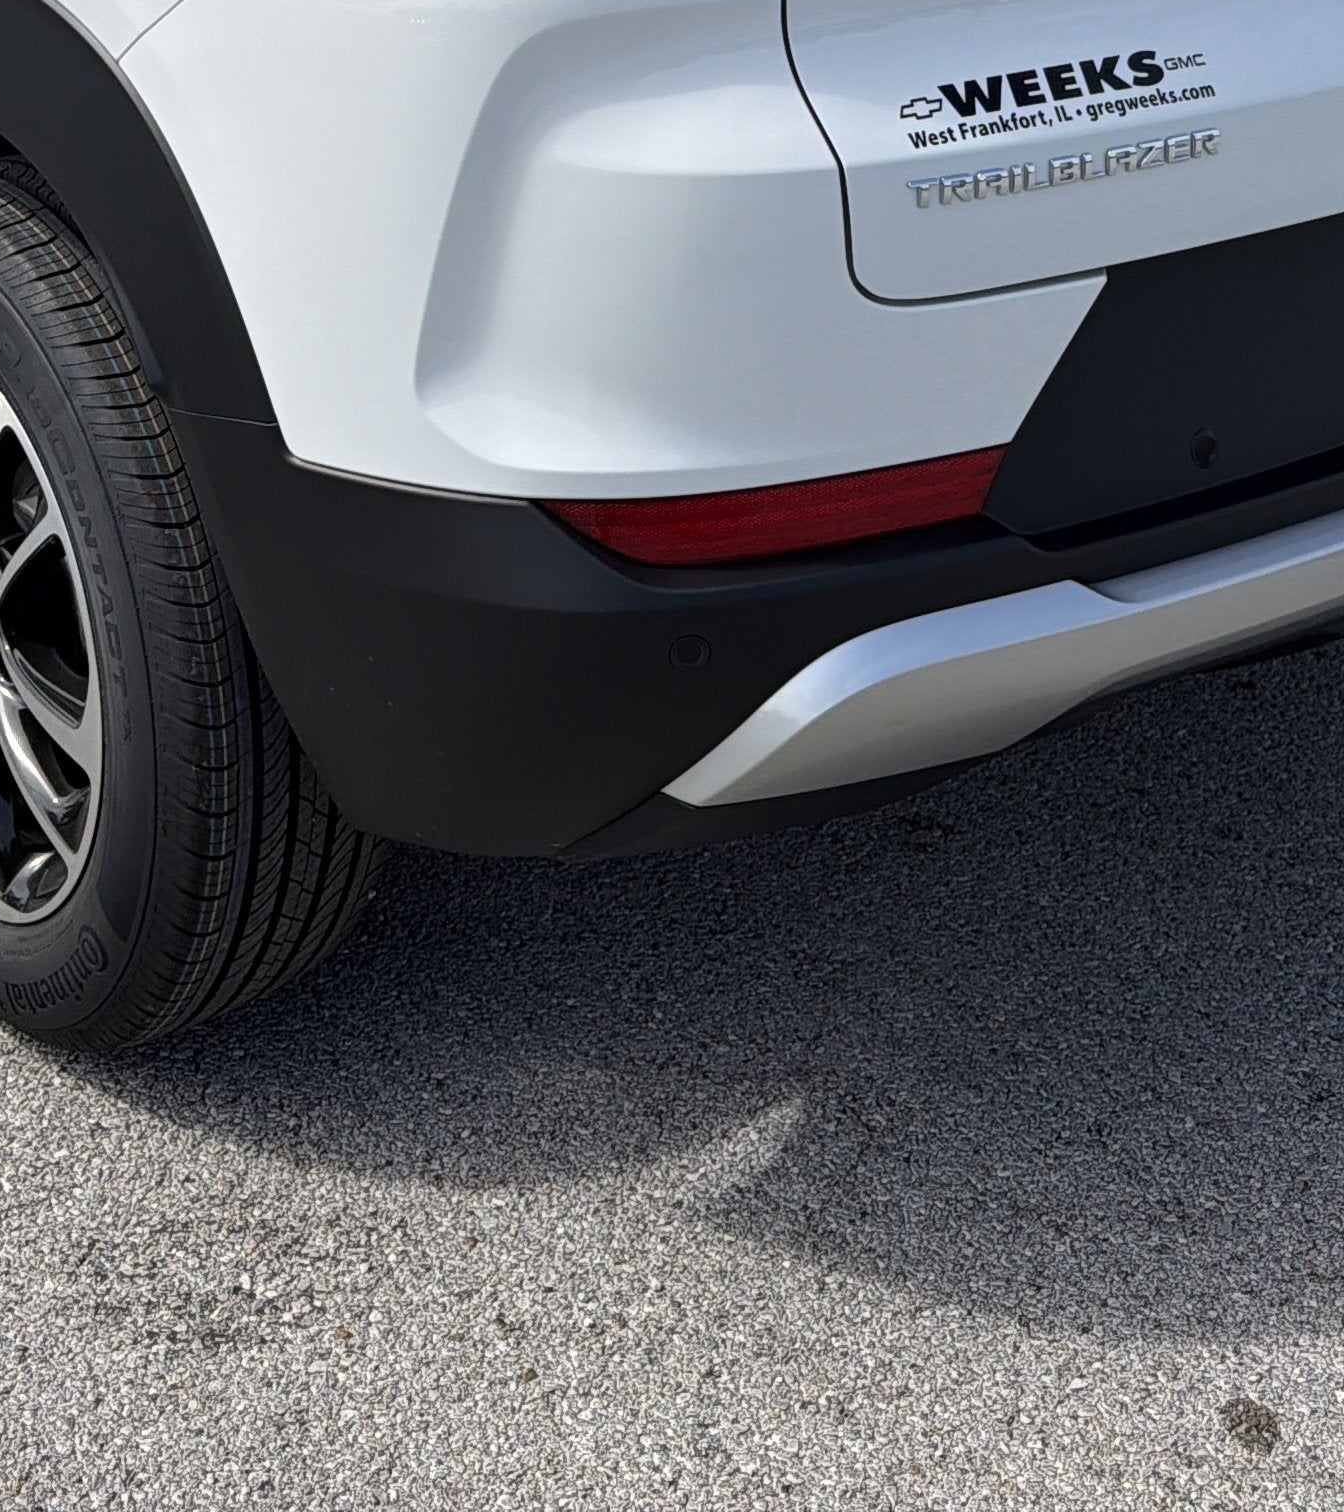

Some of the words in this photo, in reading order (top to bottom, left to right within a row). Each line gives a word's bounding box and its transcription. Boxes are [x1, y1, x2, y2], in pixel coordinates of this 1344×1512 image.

[908, 125, 957, 150] West
[959, 109, 1054, 140] Frankfort,
[1055, 106, 1073, 123] IL
[1087, 82, 1216, 122] gregweeks.com
[938, 50, 1164, 117] WEEKS
[1165, 54, 1206, 70] GMC
[907, 129, 1220, 207] TRAILBLAZER
[5, 925, 109, 1015] Continental
